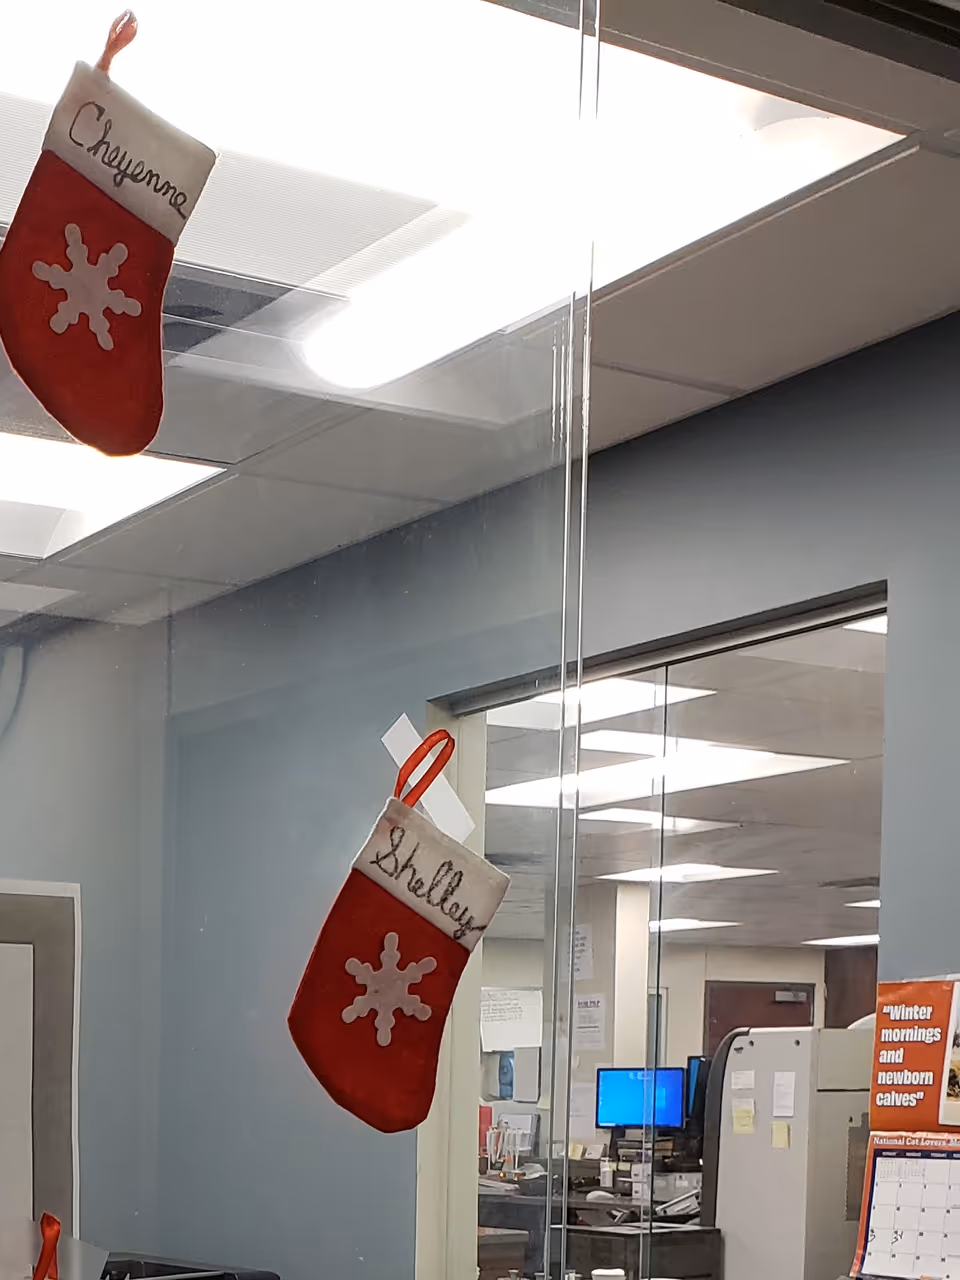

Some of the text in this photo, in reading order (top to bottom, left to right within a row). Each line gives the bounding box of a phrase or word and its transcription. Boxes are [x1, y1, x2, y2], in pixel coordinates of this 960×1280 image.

[68, 101, 188, 221] Cheyenne
[369, 826, 488, 939] Shelley
[880, 1026, 942, 1044] mornings
[878, 1048, 904, 1064] and
[877, 1069, 934, 1086] newborn
[873, 1136, 905, 1147] National
[906, 1137, 919, 1147] Cat
